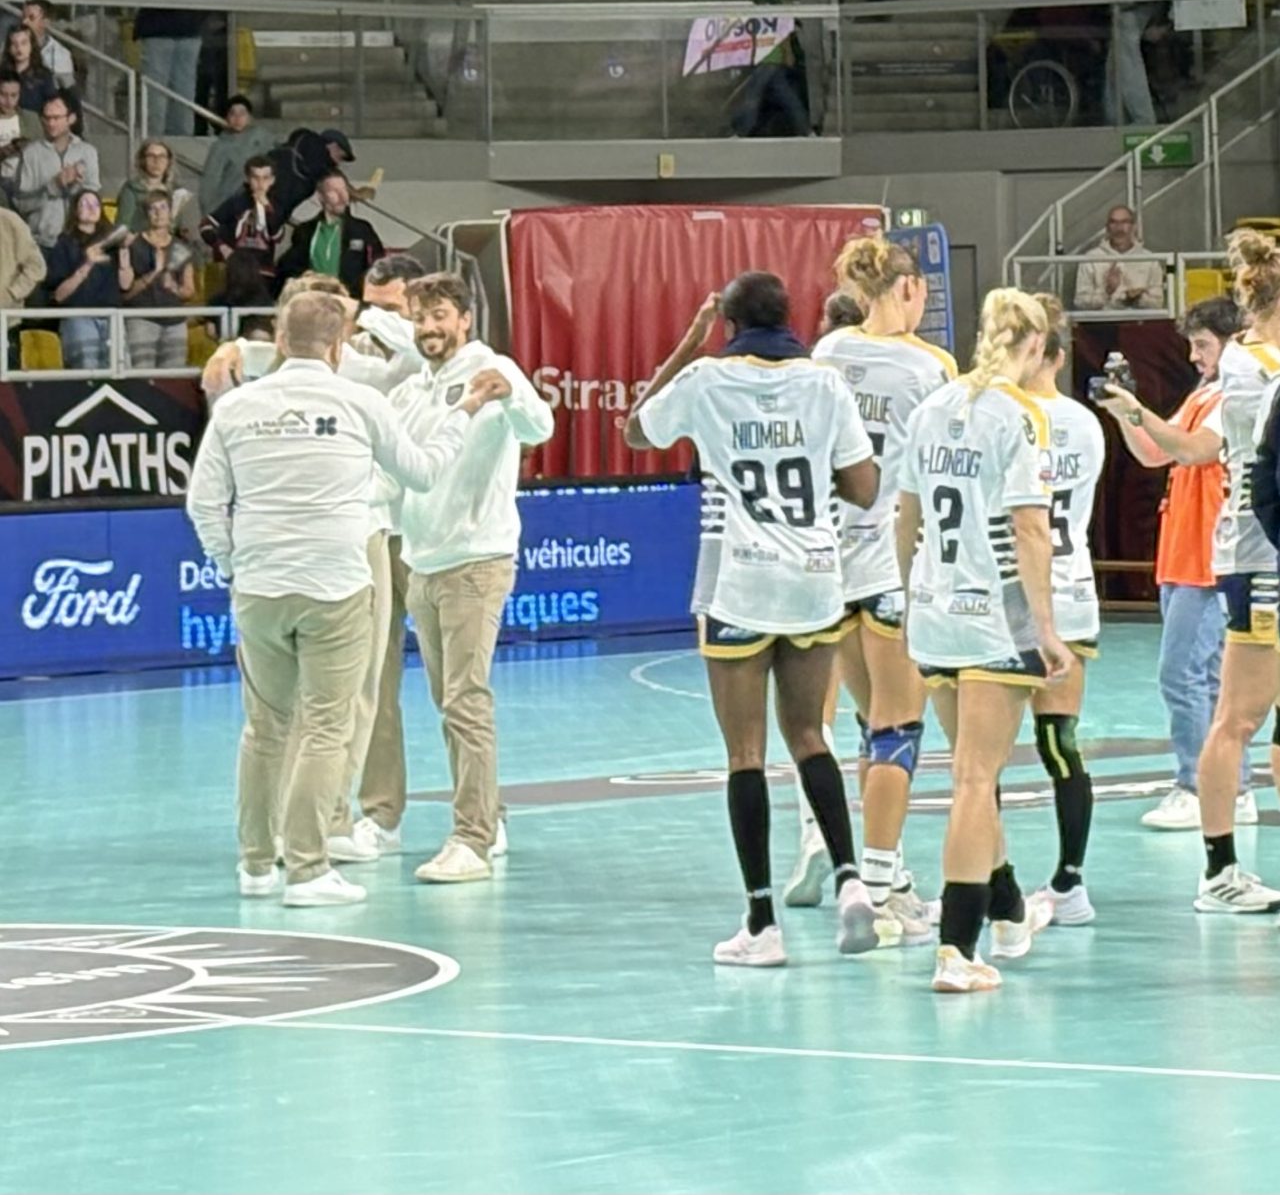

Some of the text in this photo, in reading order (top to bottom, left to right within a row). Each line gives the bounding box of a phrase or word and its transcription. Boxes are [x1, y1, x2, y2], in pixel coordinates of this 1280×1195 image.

[22, 431, 193, 501] PIRATHS
[731, 419, 805, 451] NIOMBLA
[730, 456, 816, 528] 29
[932, 485, 964, 565] 2
[1048, 489, 1075, 557] 5
[524, 538, 632, 571] véhicules
[22, 558, 143, 630] Ford
